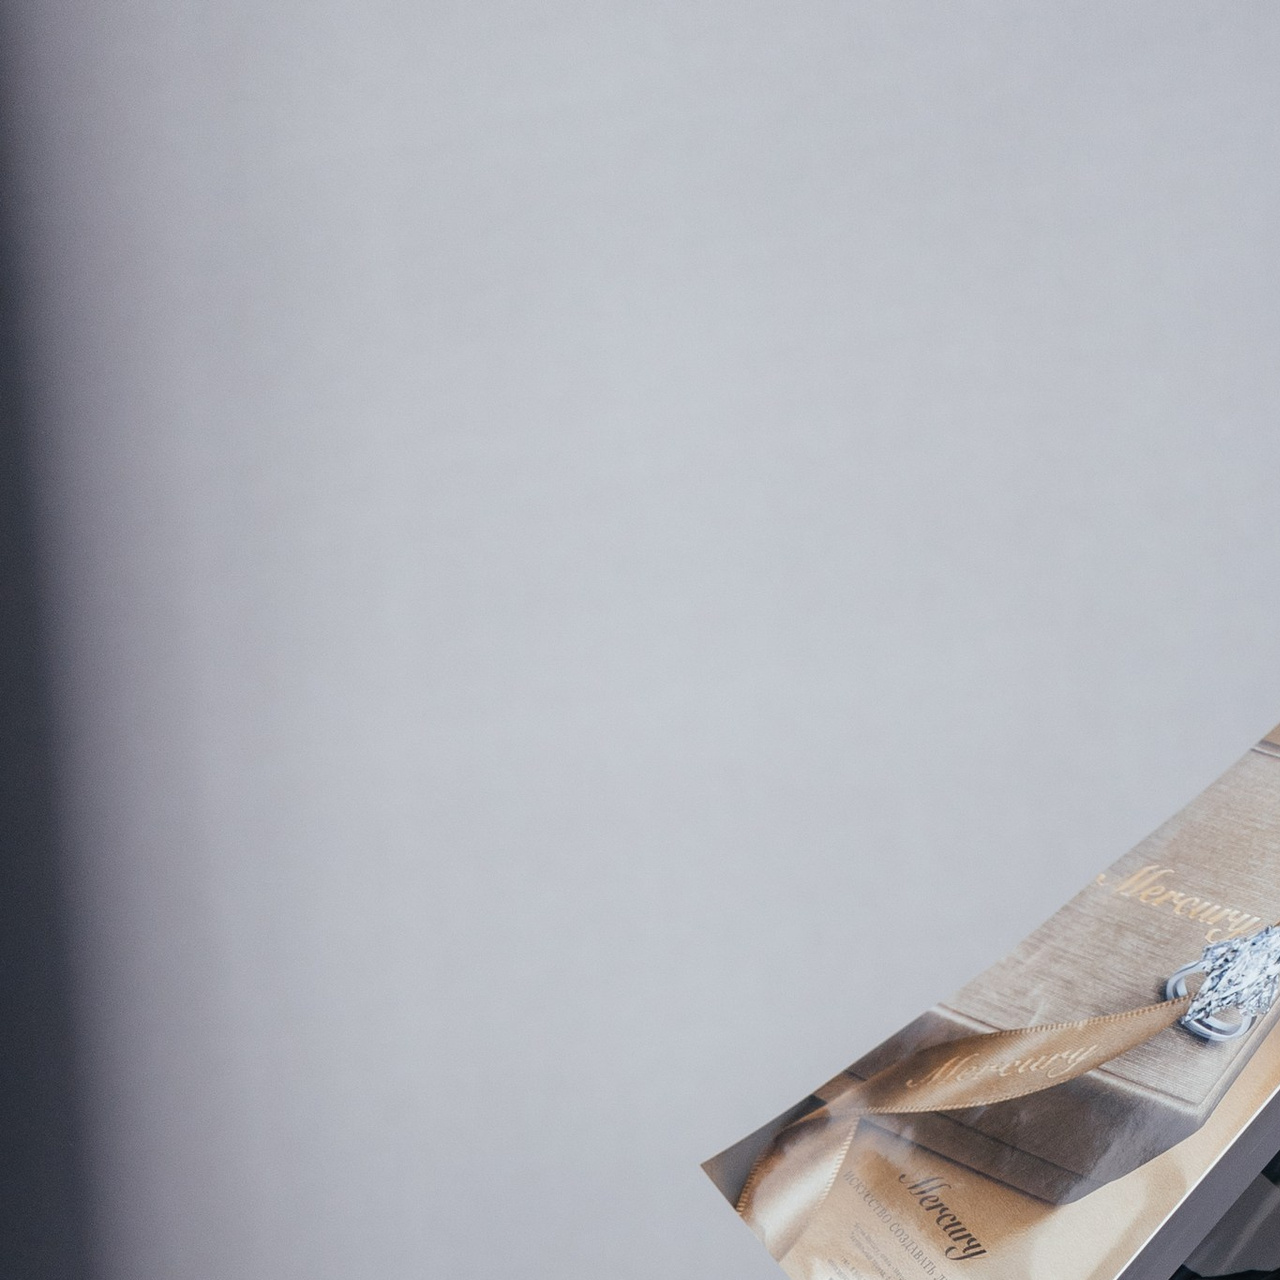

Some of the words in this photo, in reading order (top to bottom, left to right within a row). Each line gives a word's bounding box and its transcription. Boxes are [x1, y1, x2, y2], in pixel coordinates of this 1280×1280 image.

[1097, 865, 1262, 944] Mercury
[906, 1045, 1100, 1088] Mercury
[843, 1171, 892, 1225] ИСКУССТВО
[889, 1222, 938, 1277] СОЗДАВАТЬ
[899, 1173, 987, 1260] Mercury
